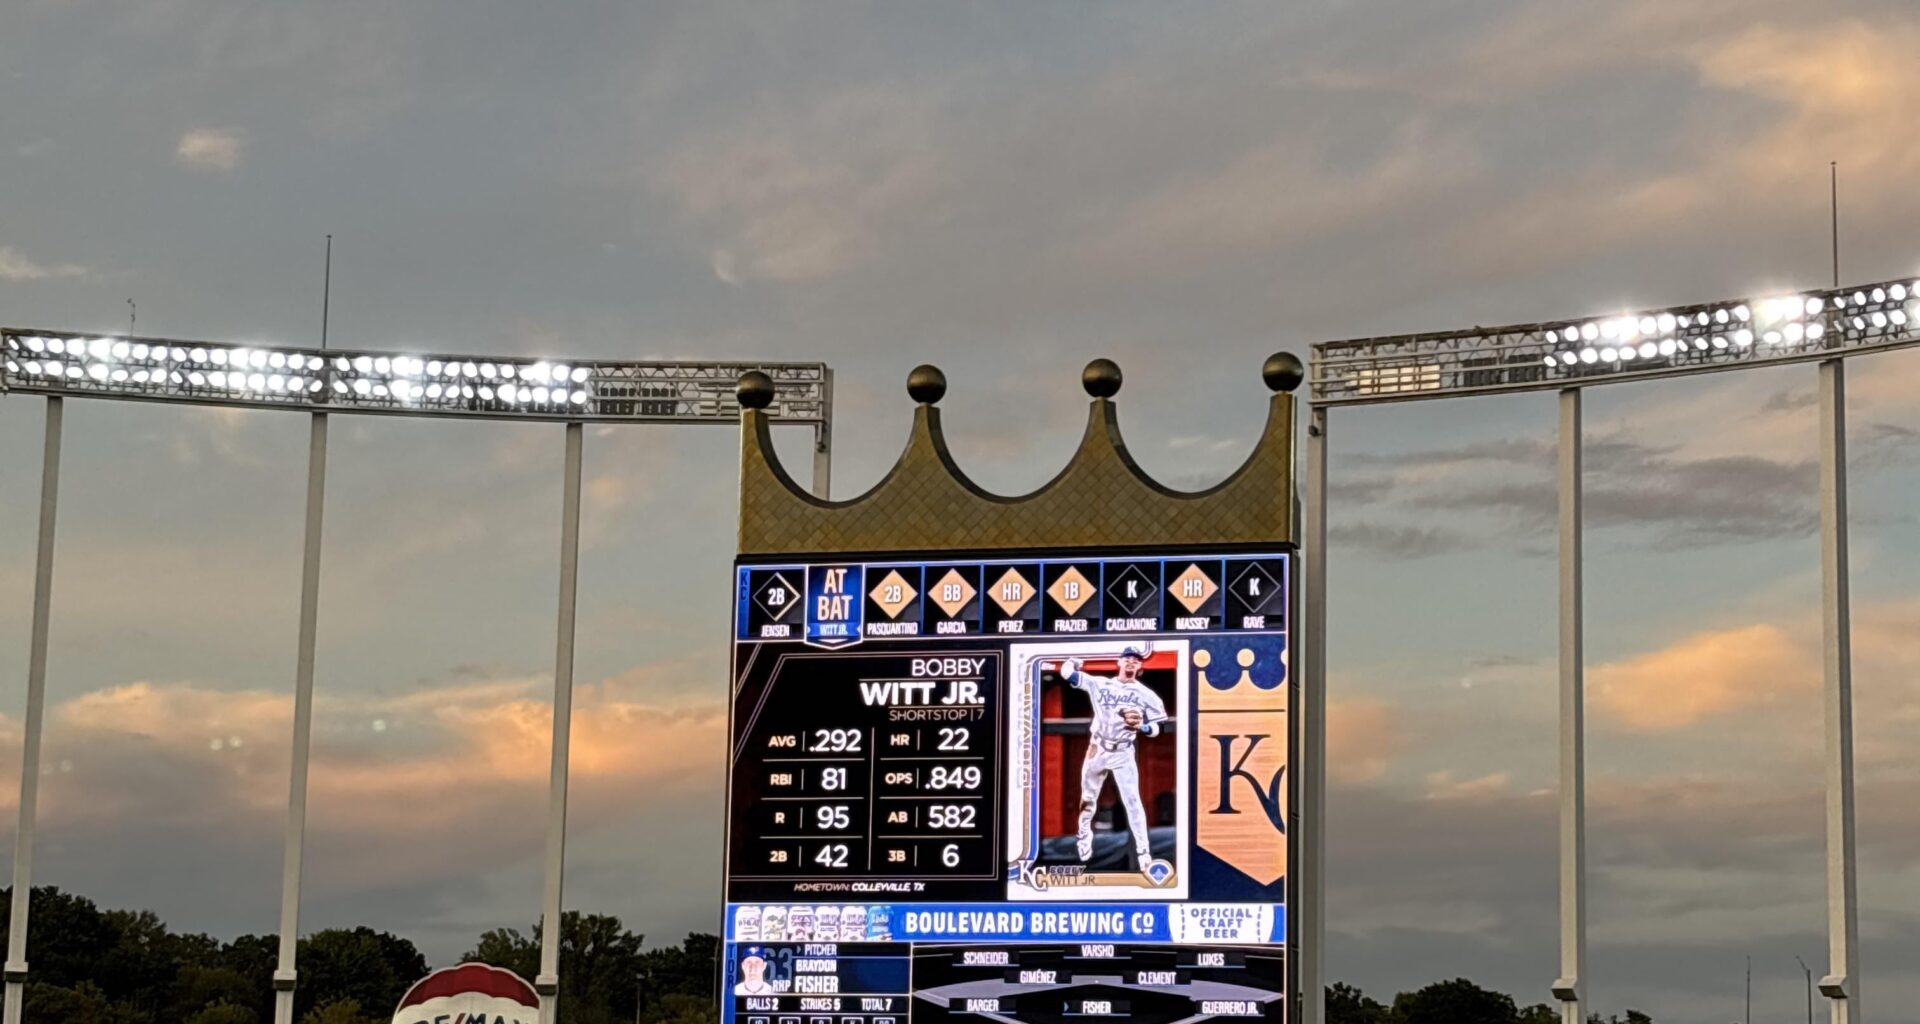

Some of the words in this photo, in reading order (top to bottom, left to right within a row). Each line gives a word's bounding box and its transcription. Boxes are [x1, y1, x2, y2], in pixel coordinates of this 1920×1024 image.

[824, 569, 847, 594] AT
[1184, 580, 1202, 596] HR
[1250, 578, 1260, 596] K
[884, 584, 902, 603] 2B
[944, 584, 962, 602] BB
[1002, 583, 1020, 600] HR
[1064, 582, 1078, 599] 1B
[1127, 580, 1138, 598] K
[768, 588, 785, 605] 2B
[817, 596, 853, 620] BAT
[868, 622, 918, 635] PASQUANTINO
[937, 621, 966, 634] GARCIA
[998, 620, 1023, 633] PEREZ
[1054, 620, 1088, 632] FRAZIER
[1106, 618, 1157, 631] CAGLIANONE
[1176, 618, 1210, 630] MASSEY
[1243, 616, 1264, 628] RAVE
[761, 625, 790, 637] JENSEN
[912, 658, 986, 676] BOBBY
[860, 682, 936, 705] WITT
[942, 681, 985, 704] JR.
[889, 710, 967, 721] SHORTSTOP
[977, 708, 984, 720] 7
[768, 736, 796, 747] AVG
[810, 729, 862, 752] .292
[890, 734, 910, 746] HR
[938, 728, 970, 750] 22
[770, 774, 792, 786] RBI
[822, 768, 846, 790] 81
[885, 773, 913, 784] OPS
[925, 766, 981, 790] .849
[775, 812, 785, 824] R
[817, 806, 850, 828] 95
[888, 812, 908, 823] AB
[928, 806, 976, 828] 582
[770, 851, 788, 862] 2B
[814, 845, 848, 867] 42
[888, 850, 906, 862] 3B
[942, 844, 960, 867] 6
[1018, 860, 1047, 891] KC
[1050, 875, 1078, 886] WITT
[794, 882, 850, 892] HOMETOWN:
[914, 882, 926, 892] TX
[1191, 908, 1252, 918] OFFICIAL
[906, 912, 1024, 933] BOULEVARD
[1031, 912, 1124, 934] BREWING
[1200, 918, 1244, 928] CRAFT
[1204, 929, 1238, 938] BEER
[805, 944, 837, 956] PITCHER
[1082, 945, 1114, 957] VARSHO
[964, 952, 1008, 964] SCHNEIDER
[1198, 953, 1224, 966] LUKES
[796, 960, 836, 972] BRAYDON
[1020, 969, 1056, 984] GIMÉNEZ
[1138, 972, 1176, 984] CLEMENT
[772, 980, 790, 992] RHP
[795, 976, 838, 993] FISHER
[746, 998, 770, 1010] BALLS
[772, 998, 778, 1010] 2
[800, 998, 832, 1010] STRIKES
[862, 998, 884, 1010] TOTAL
[886, 998, 892, 1010] 7
[966, 999, 999, 1012] BARGER
[1082, 1002, 1112, 1014] FISHER
[1202, 1001, 1246, 1014] GUERRERO
[1246, 1002, 1259, 1014] JR.
